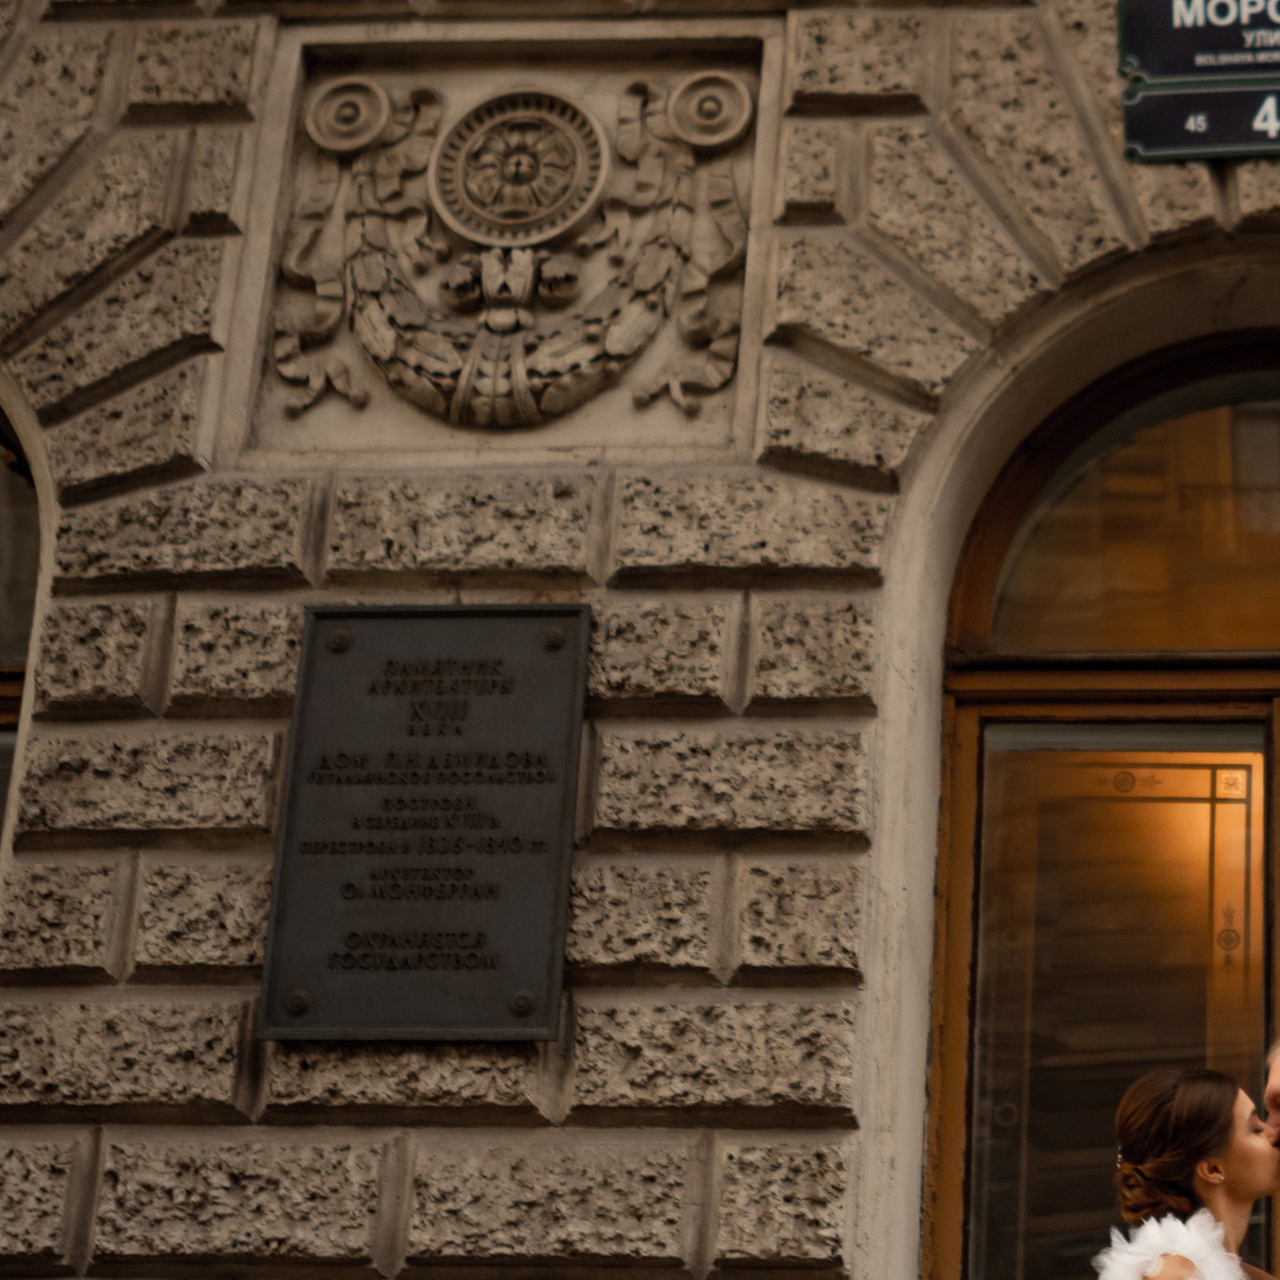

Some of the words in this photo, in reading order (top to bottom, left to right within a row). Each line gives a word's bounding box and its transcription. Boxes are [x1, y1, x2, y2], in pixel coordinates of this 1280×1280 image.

[1185, 113, 1208, 133] 45
[318, 752, 369, 770] ДОМ
[346, 932, 488, 950] ОХРАНЯЕТСЯ
[328, 952, 501, 971] ГОСУДАРСТВОМ
